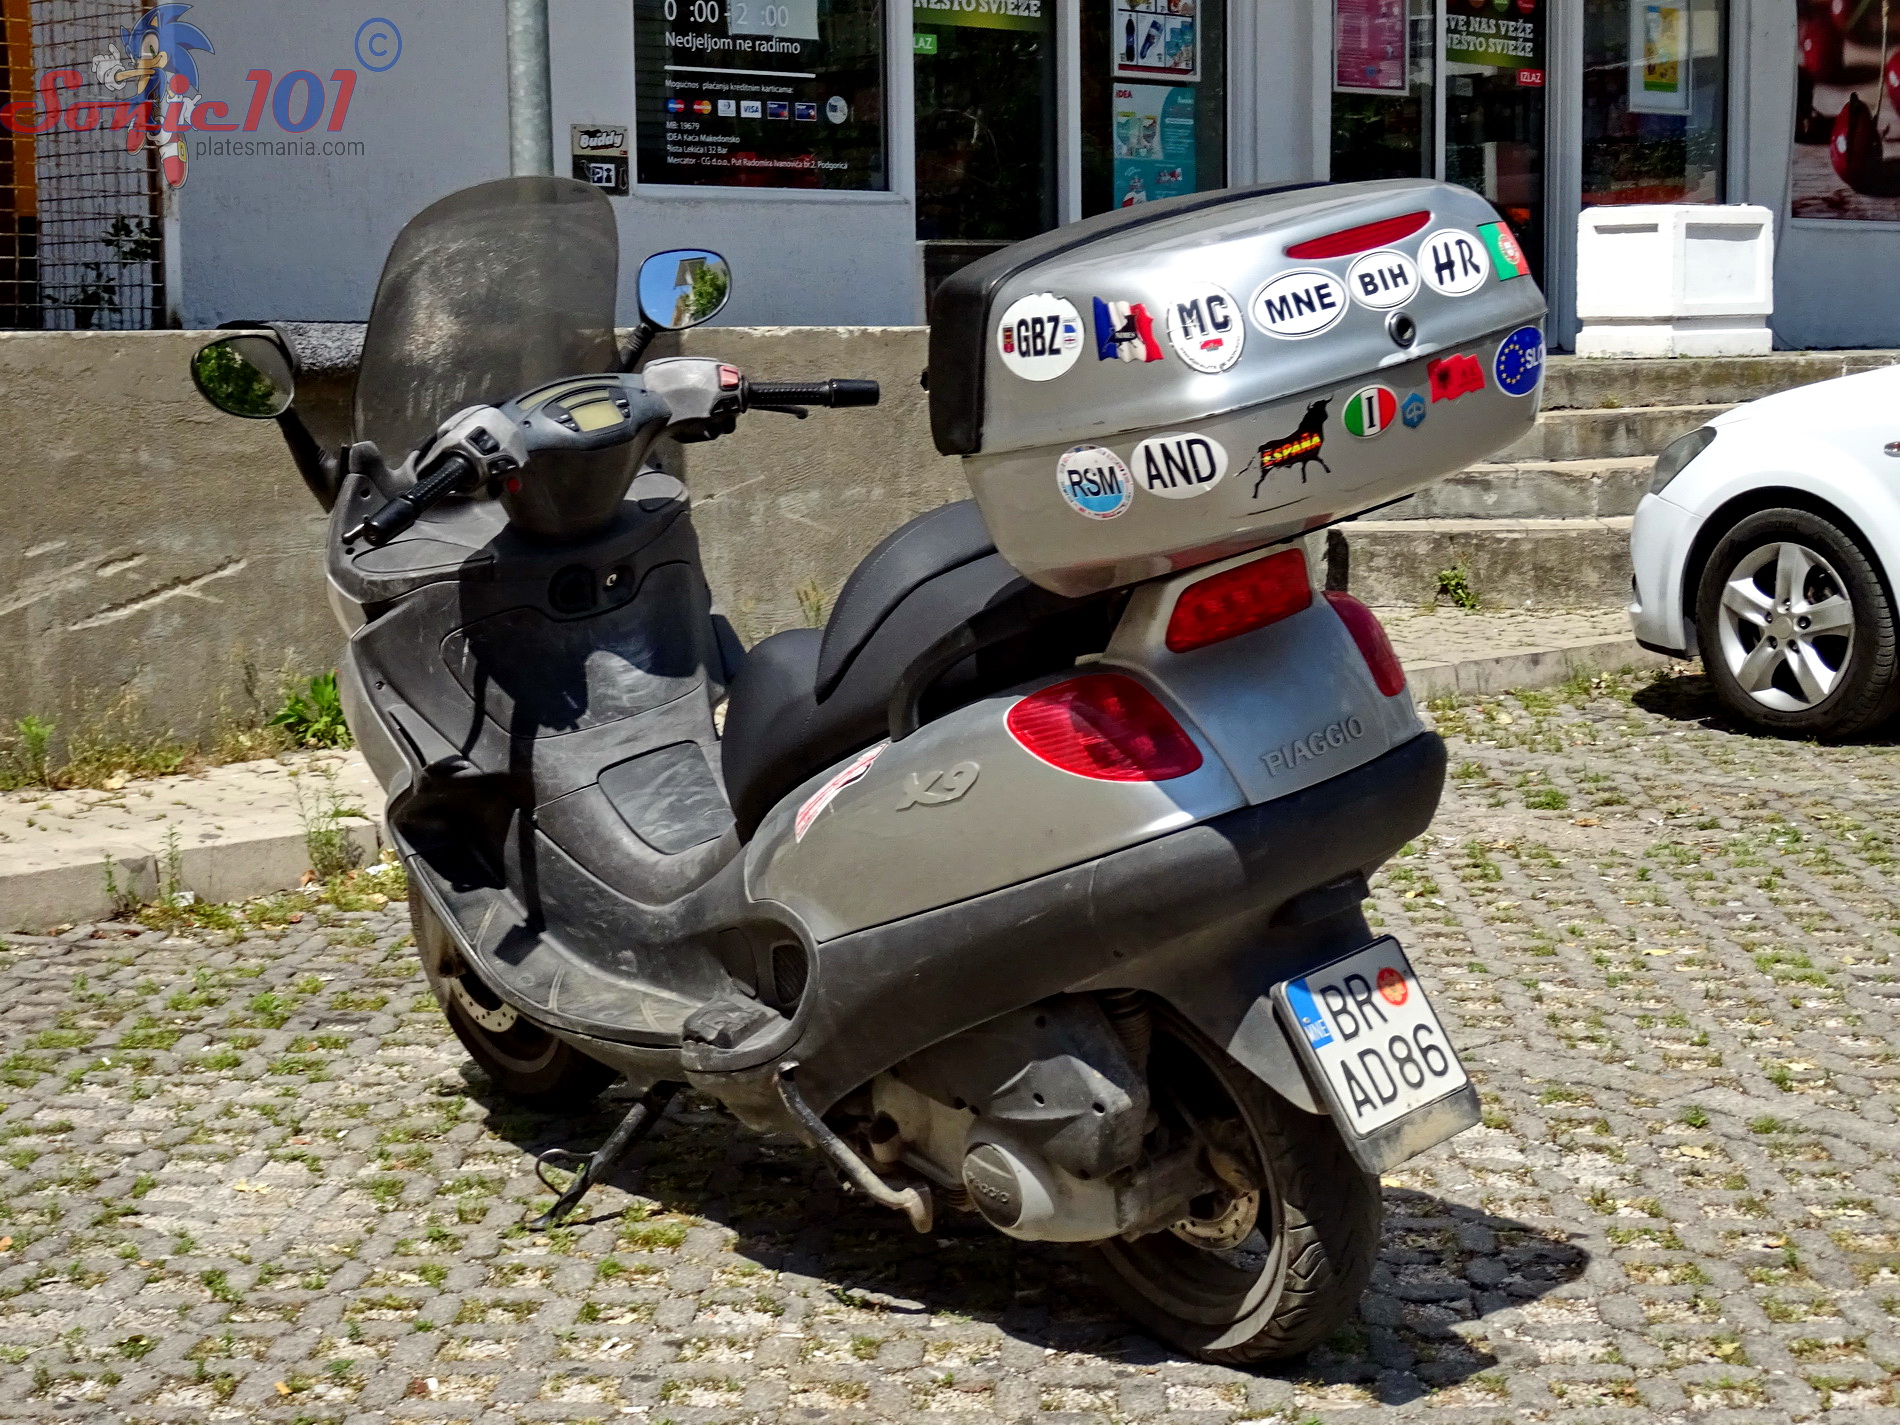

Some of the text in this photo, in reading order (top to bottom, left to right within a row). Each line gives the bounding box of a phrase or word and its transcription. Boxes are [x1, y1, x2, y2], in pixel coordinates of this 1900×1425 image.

[665, 31, 801, 54] Nedjeljom ne radimo
[1446, 14, 1534, 39] VE NAS VEŽE
[743, 105, 760, 114] VISA
[579, 130, 625, 150] Buddy
[1358, 263, 1409, 297] BIH
[1431, 237, 1481, 286] HR
[1176, 294, 1232, 340] MC
[1264, 282, 1337, 324] MNE
[1016, 314, 1062, 358] GBZ
[1365, 395, 1377, 429] I
[1066, 465, 1123, 498] RSM
[1144, 438, 1217, 490] AND
[1260, 715, 1364, 777] PIAGGIO
[1319, 973, 1389, 1041] BR
[1304, 1019, 1331, 1043] MNE
[1340, 1023, 1450, 1118] AD86
